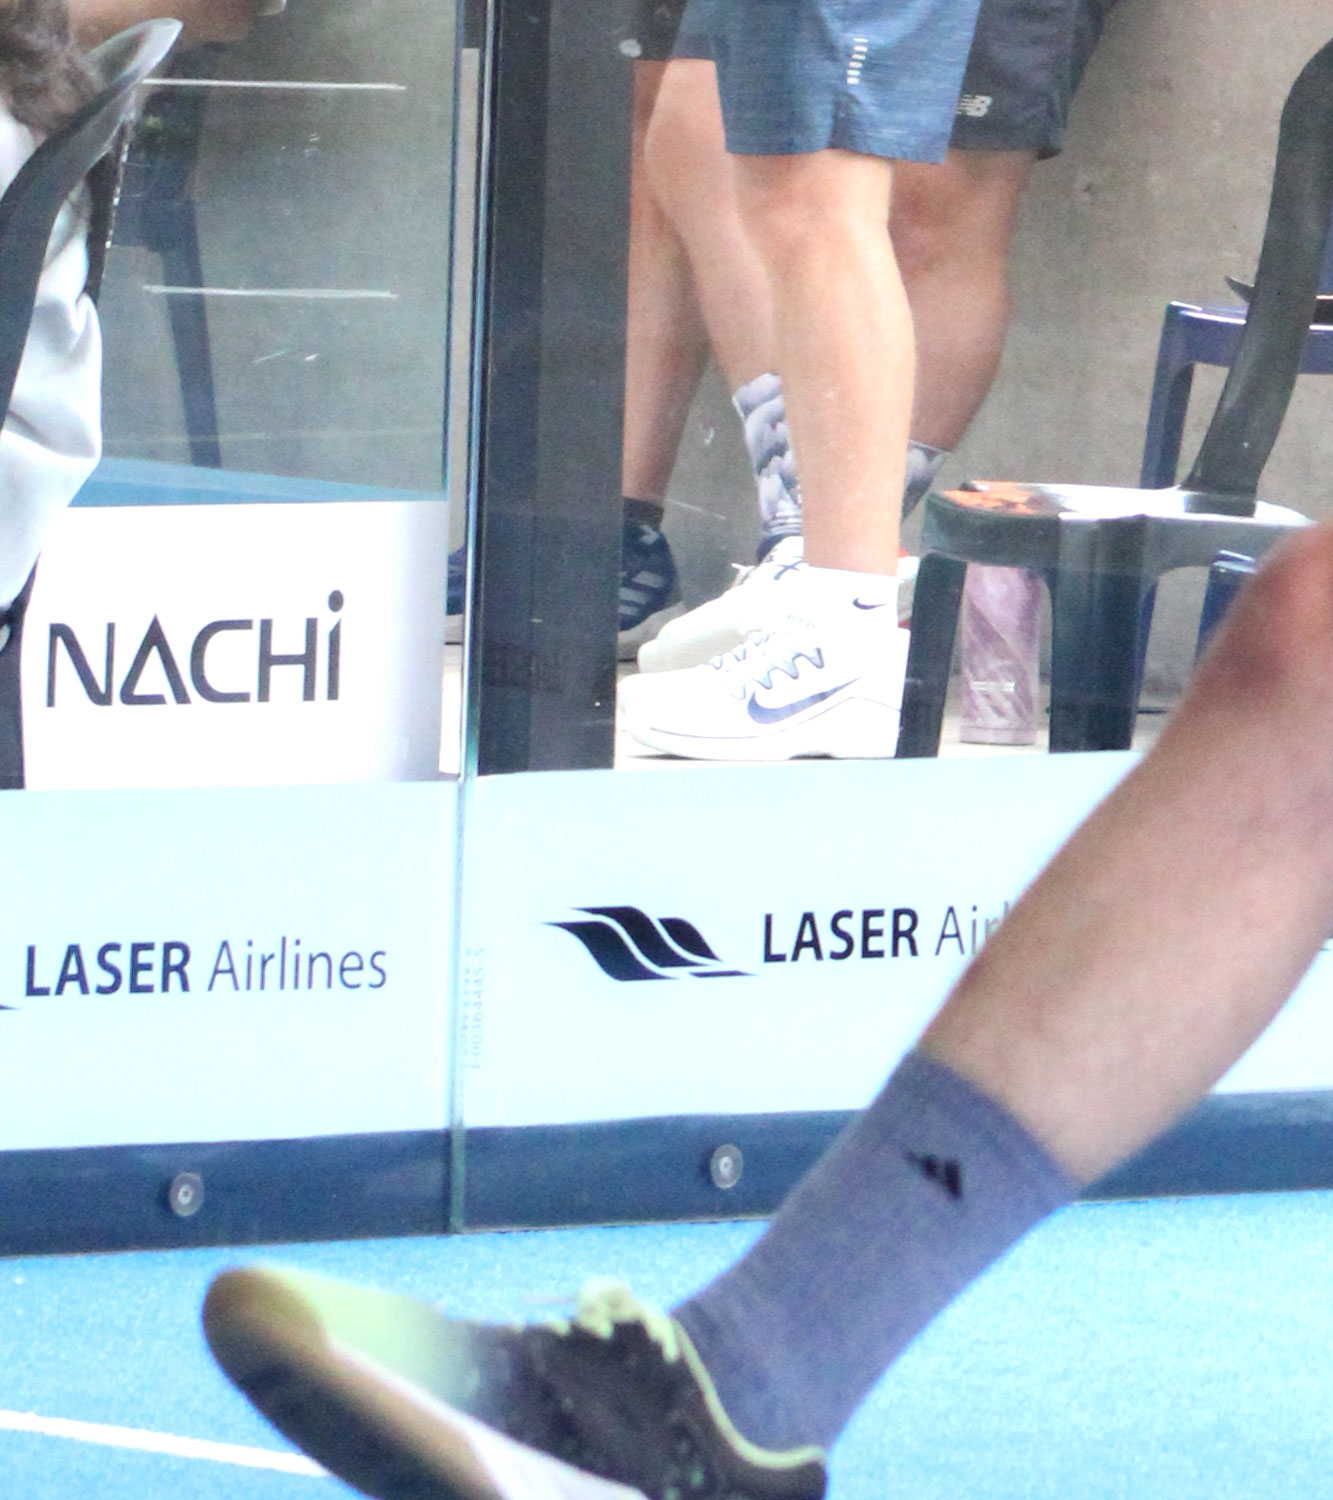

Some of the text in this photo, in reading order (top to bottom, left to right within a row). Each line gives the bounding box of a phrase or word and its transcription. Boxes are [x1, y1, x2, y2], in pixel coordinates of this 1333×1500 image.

[763, 907, 920, 963] LASER
[25, 936, 388, 998] LASER Airlines
